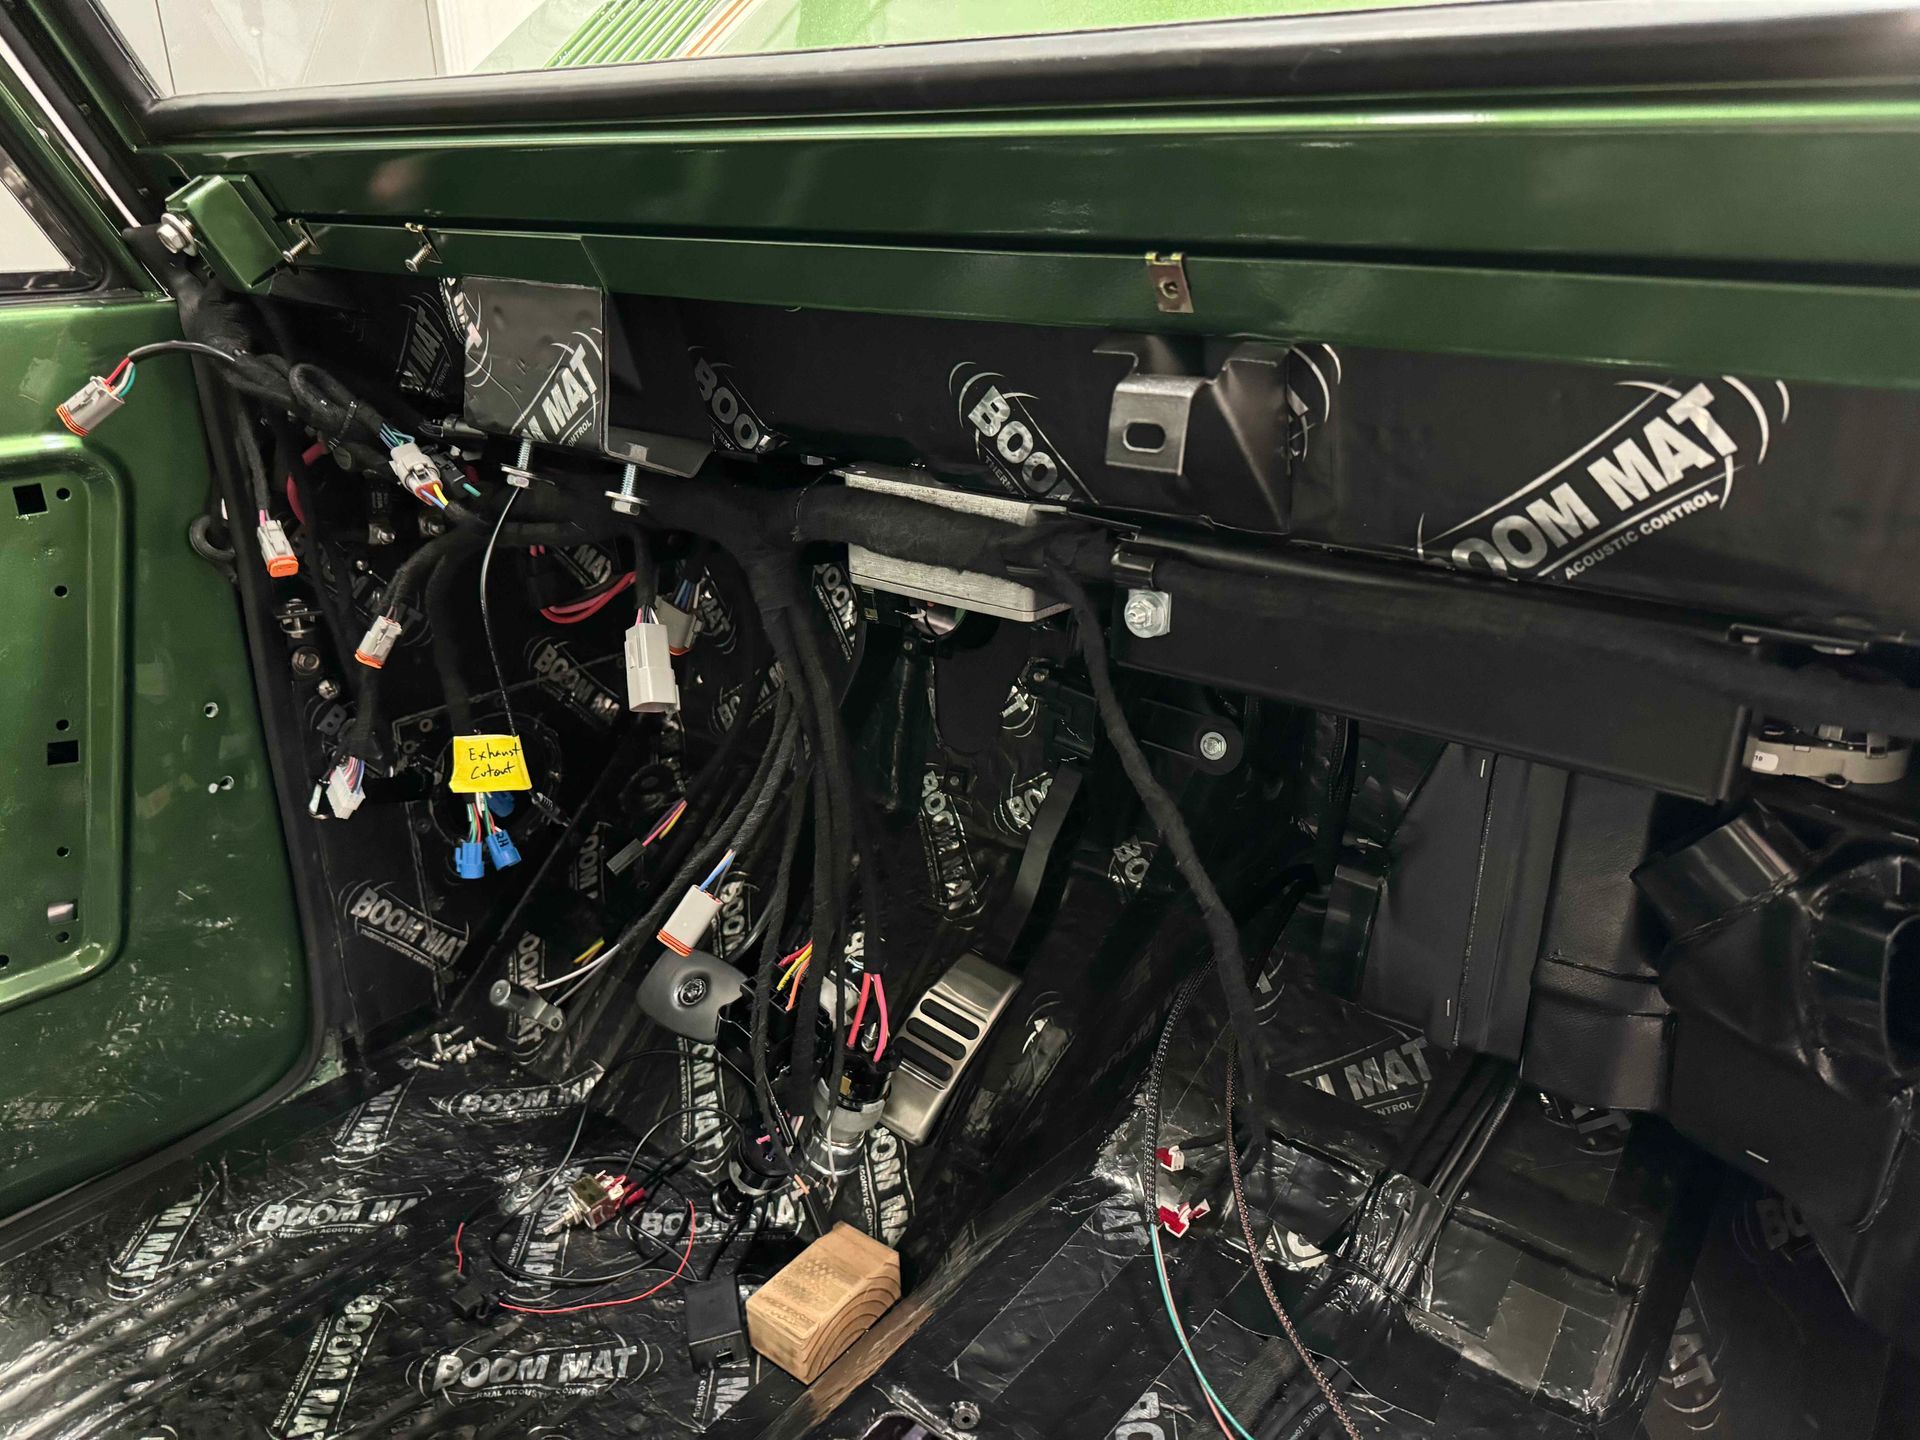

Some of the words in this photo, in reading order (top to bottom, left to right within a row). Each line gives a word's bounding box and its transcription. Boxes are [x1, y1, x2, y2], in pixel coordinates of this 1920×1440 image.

[541, 343, 598, 436] MAT
[567, 418, 592, 448] ONTROL
[1586, 382, 1739, 512] MAT
[1563, 529, 1640, 581] ACOUSTIC
[1639, 489, 1721, 536] CONTROL
[350, 886, 425, 944] BOOM
[1343, 1035, 1433, 1101] MAT
[255, 1203, 365, 1232] BOOM
[313, 1294, 384, 1380] BOOM
[432, 1353, 550, 1392] BOOM
[558, 1345, 638, 1383] MAT
